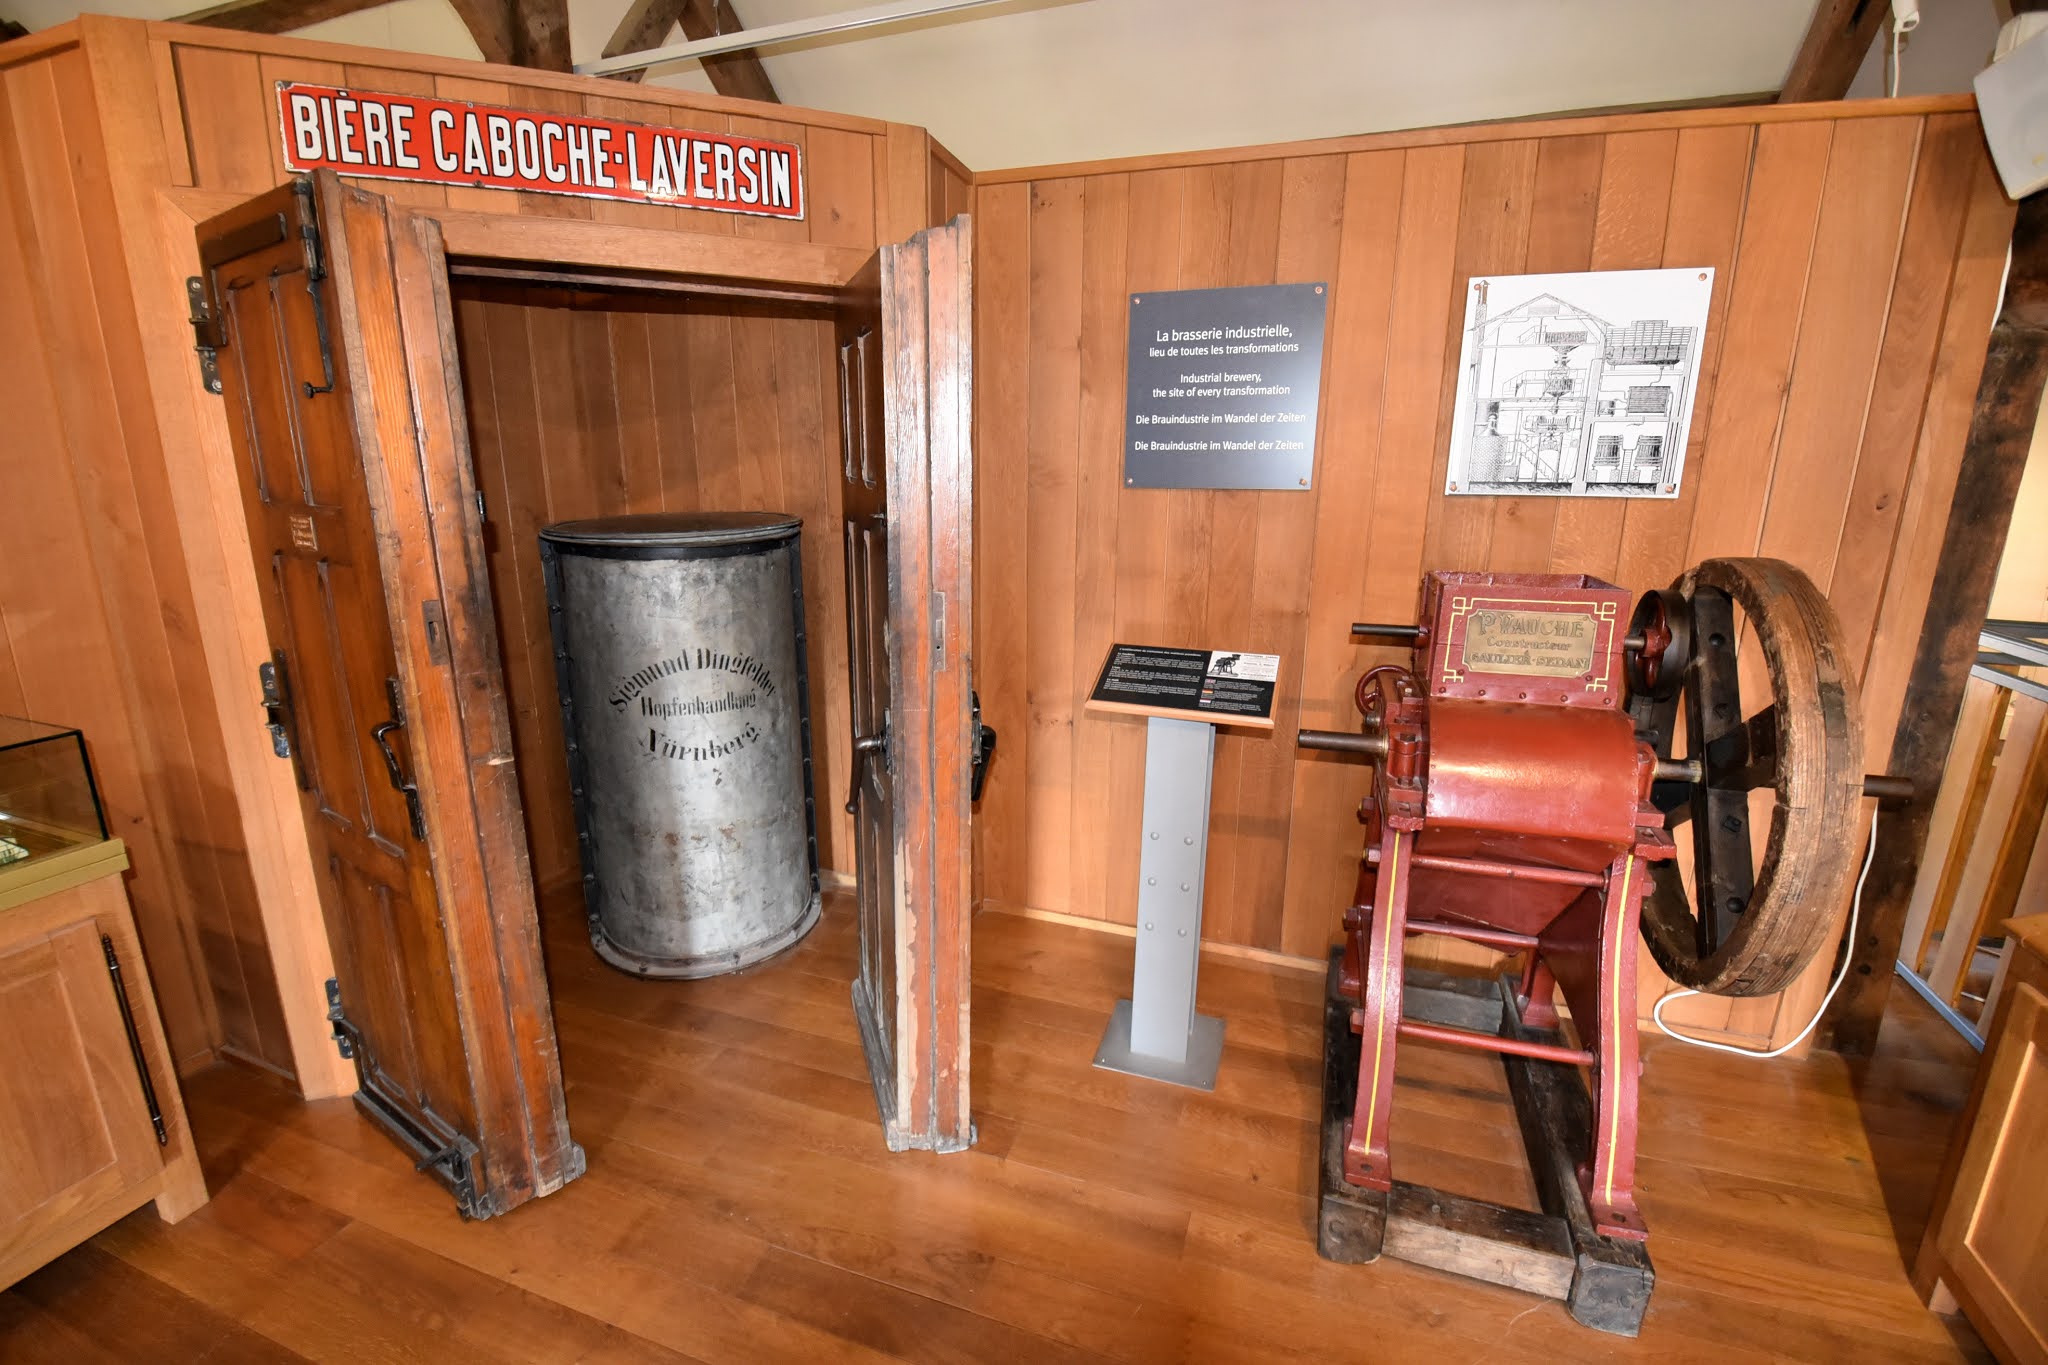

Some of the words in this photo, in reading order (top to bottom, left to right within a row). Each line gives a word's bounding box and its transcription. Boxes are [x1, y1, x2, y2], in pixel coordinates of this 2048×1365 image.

[290, 89, 420, 170] BIÈRE
[1156, 330, 1169, 342] La
[1171, 327, 1223, 342] brasserie
[1225, 324, 1293, 339] industrielle,
[1149, 347, 1165, 357] lieu
[1167, 346, 1179, 357] de
[1180, 346, 1209, 356] toutes
[1210, 344, 1224, 355] les
[1226, 342, 1299, 355] transformations
[1180, 372, 1222, 383] Industrial
[1224, 372, 1262, 383] brewery,
[1152, 387, 1167, 398] the
[1168, 387, 1185, 397] site
[1186, 386, 1196, 397] of
[1197, 388, 1222, 398] every
[1223, 384, 1291, 396] transformation
[1135, 414, 1150, 424] Die
[1151, 413, 1209, 424] Brauindustrie
[1211, 413, 1223, 424] im
[1224, 412, 1258, 424] Wandel
[1260, 412, 1276, 423] der
[1277, 412, 1306, 423] Zeiten
[1134, 441, 1149, 451] Die
[1150, 440, 1208, 451] Brauindustrie
[1209, 440, 1221, 450] im
[1222, 440, 1257, 450] Wandel
[1258, 440, 1274, 450] der
[1275, 440, 1304, 450] Zeiten
[609, 648, 690, 713] Sigmund
[641, 688, 756, 720] Hopfenhandlung
